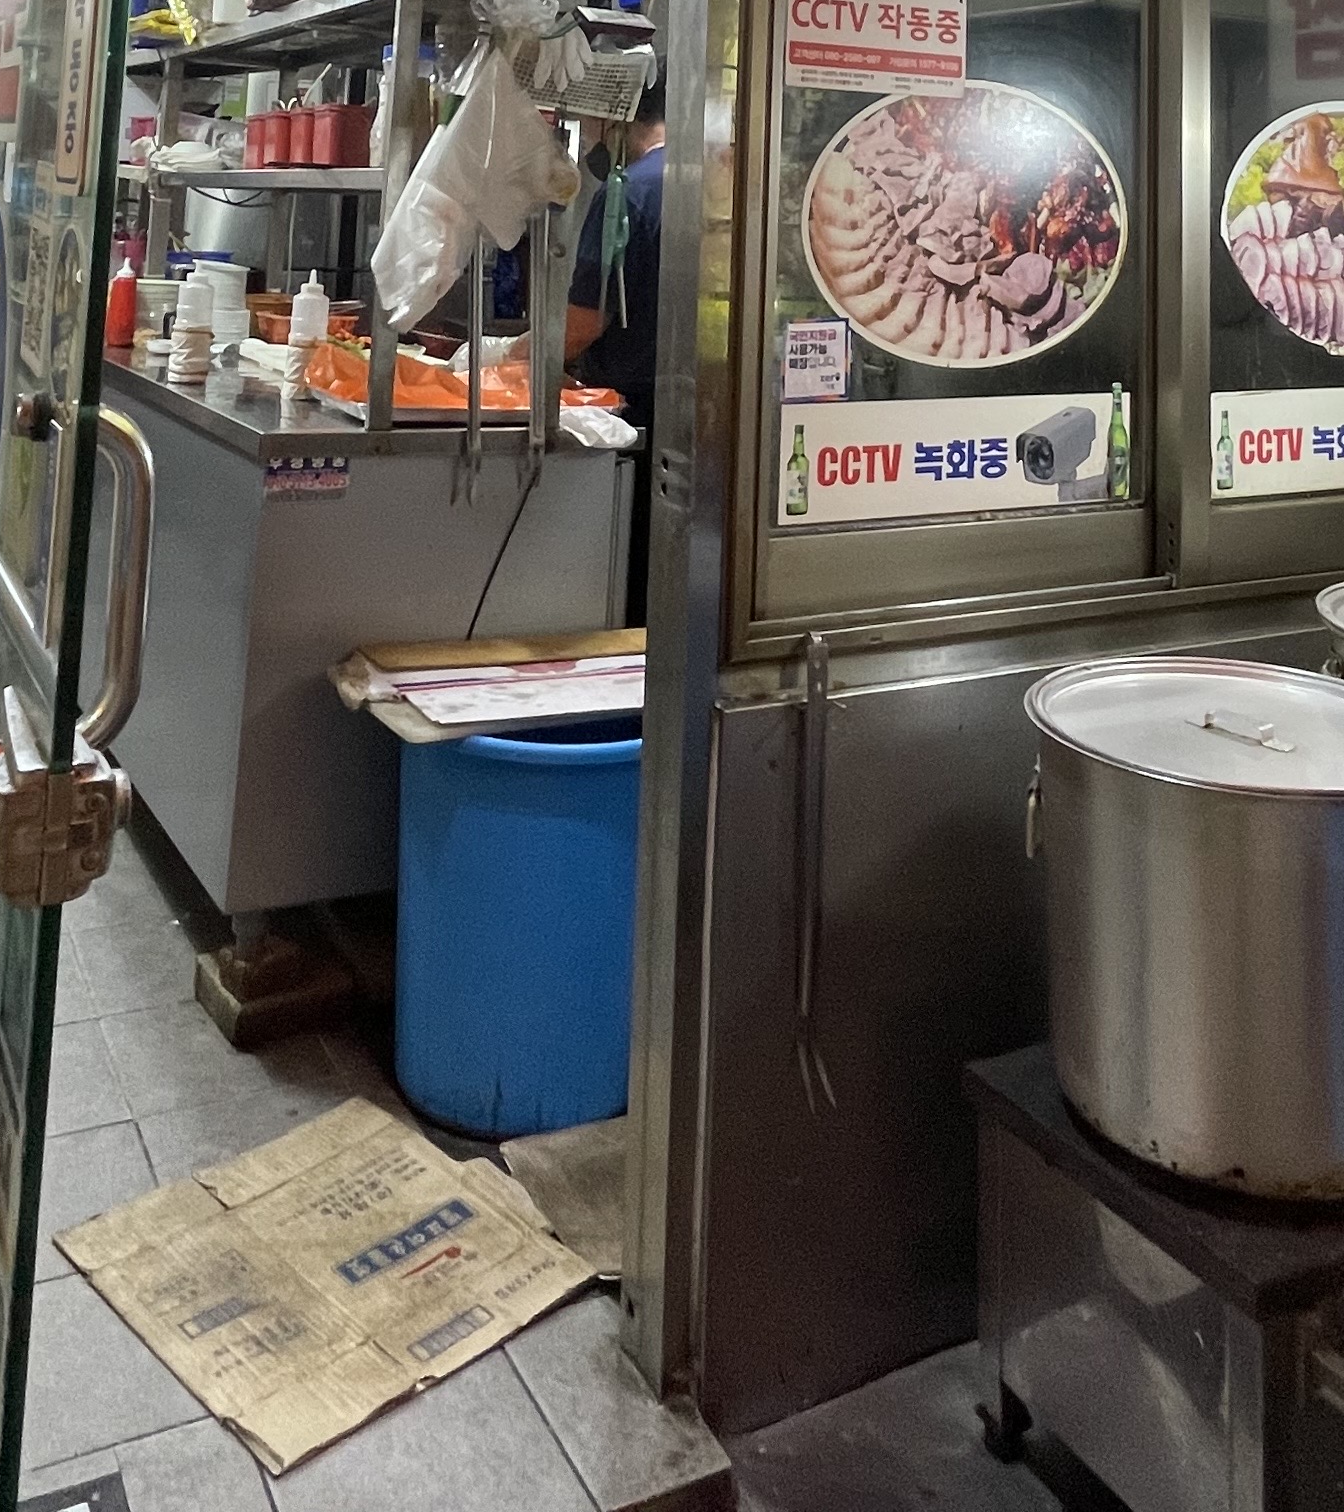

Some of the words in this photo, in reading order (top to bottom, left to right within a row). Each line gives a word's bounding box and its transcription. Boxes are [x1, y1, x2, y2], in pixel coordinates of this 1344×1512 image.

[877, 3, 961, 44] 작동중
[817, 444, 902, 487] CCTV
[913, 438, 1009, 482] 녹화중
[1239, 428, 1303, 464] CCTV
